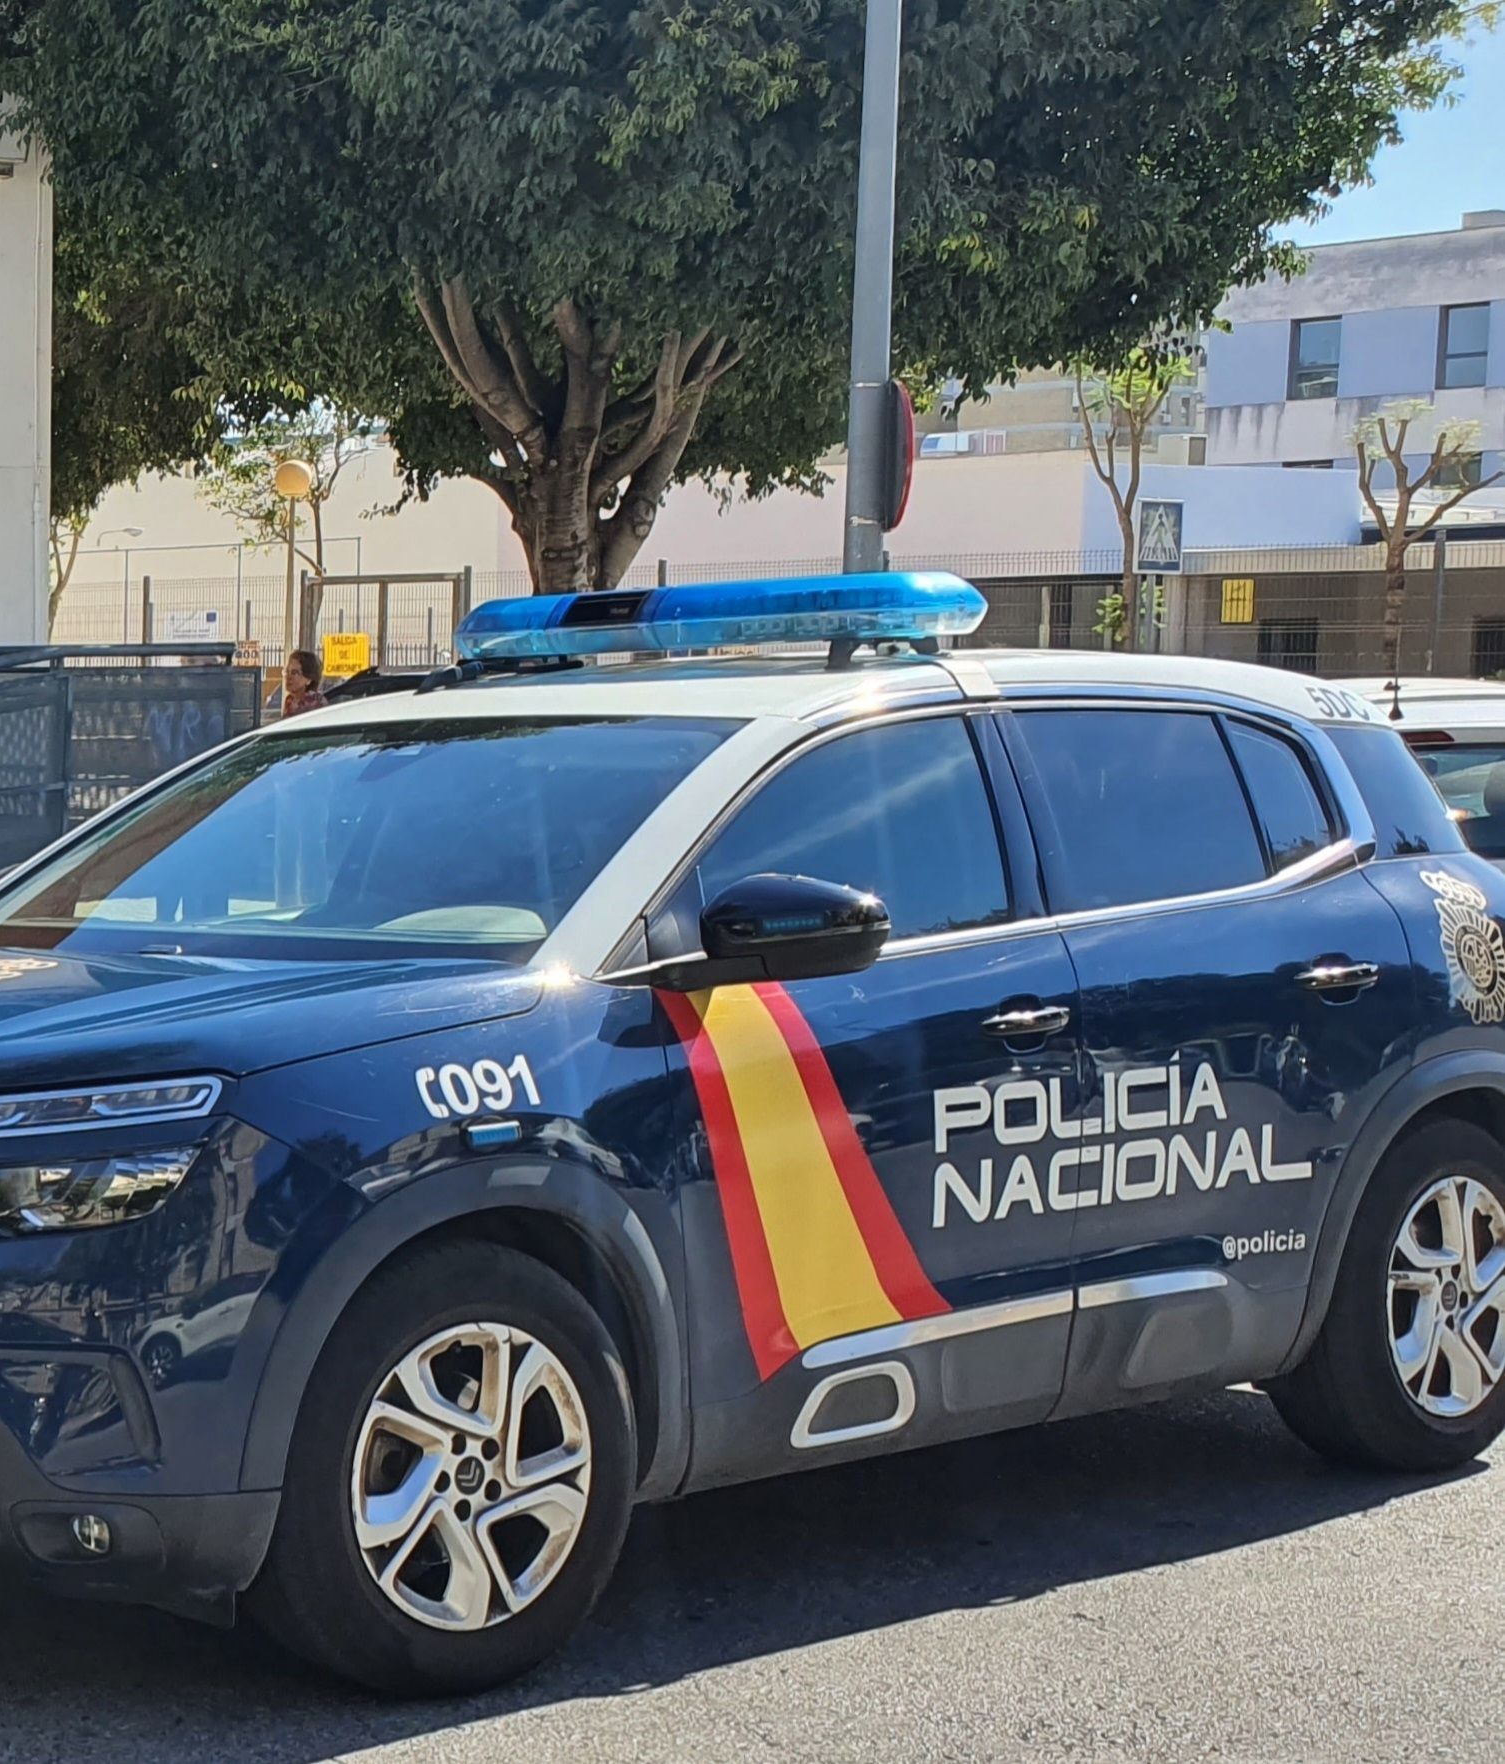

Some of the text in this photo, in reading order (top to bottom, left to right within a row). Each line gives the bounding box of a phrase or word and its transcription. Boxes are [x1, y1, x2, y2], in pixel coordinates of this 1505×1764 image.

[439, 1054, 541, 1116] 091
[933, 1049, 1227, 1154] POLICÍA
[932, 1123, 1313, 1228] NACIONAL
[1222, 1228, 1306, 1261] @policia
